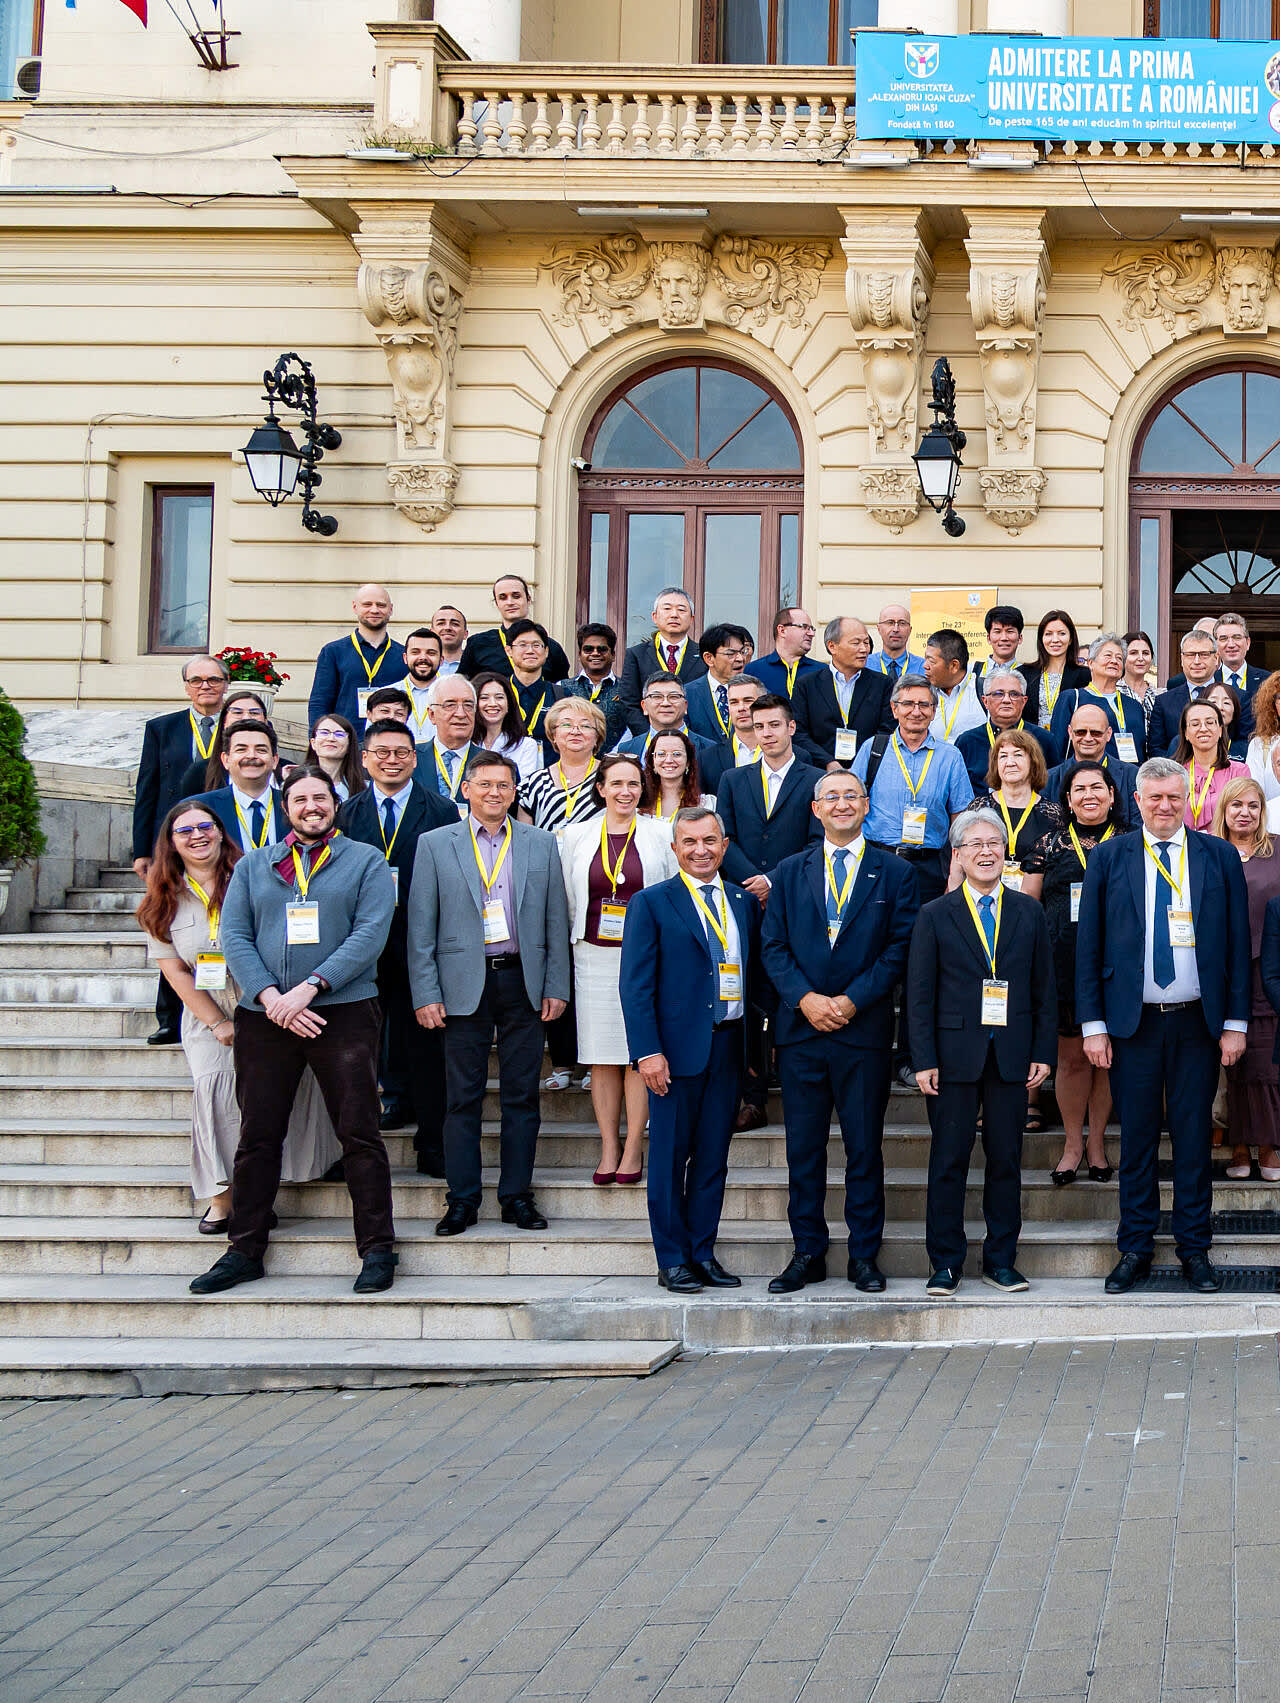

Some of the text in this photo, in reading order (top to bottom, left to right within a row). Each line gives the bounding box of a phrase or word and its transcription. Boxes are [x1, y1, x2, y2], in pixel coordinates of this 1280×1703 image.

[988, 47, 1194, 79] ADMITERE LA PRIMA
[890, 83, 954, 92] UNIVERSITATEA
[925, 94, 945, 102] IOAN
[988, 80, 1259, 114] UNIVERSITATE A ROMÂNIEI
[905, 103, 938, 113] DIN IAȘI
[888, 120, 955, 129] Fondată în 1860
[988, 117, 1236, 131] De peste 165 de ani educăm în spiritul excelenței
